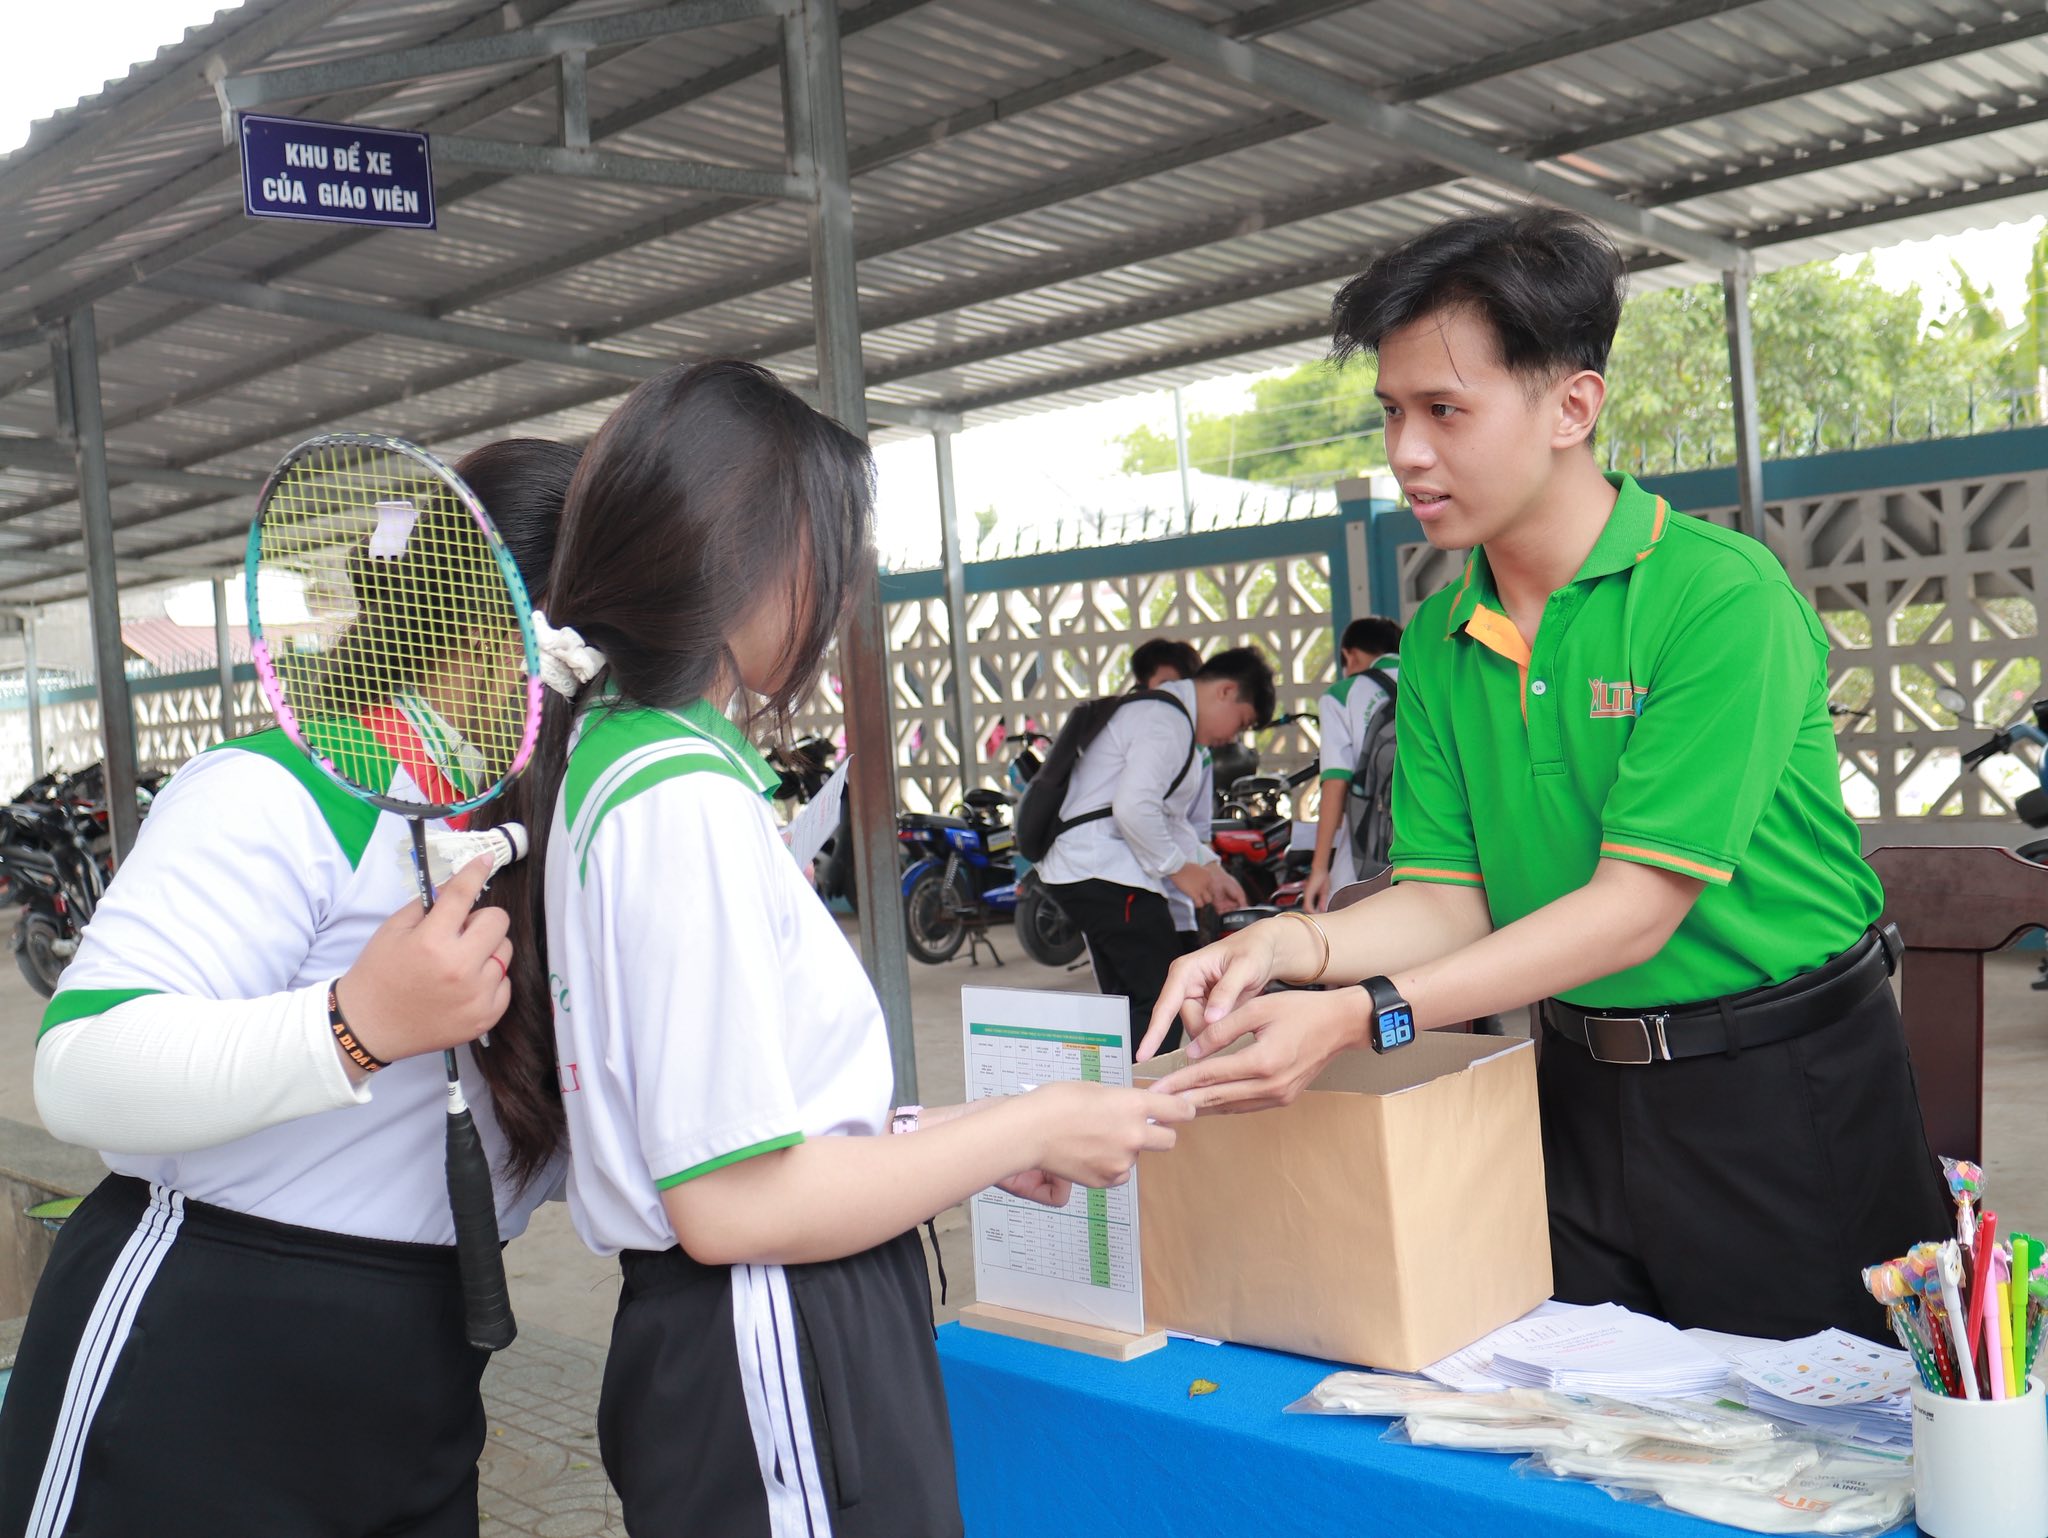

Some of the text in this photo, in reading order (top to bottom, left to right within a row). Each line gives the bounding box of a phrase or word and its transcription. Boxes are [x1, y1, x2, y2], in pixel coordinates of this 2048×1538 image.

[284, 141, 393, 175] KHU ĐỂ XE
[262, 172, 420, 213] CỦA GIÁO VIÊN
